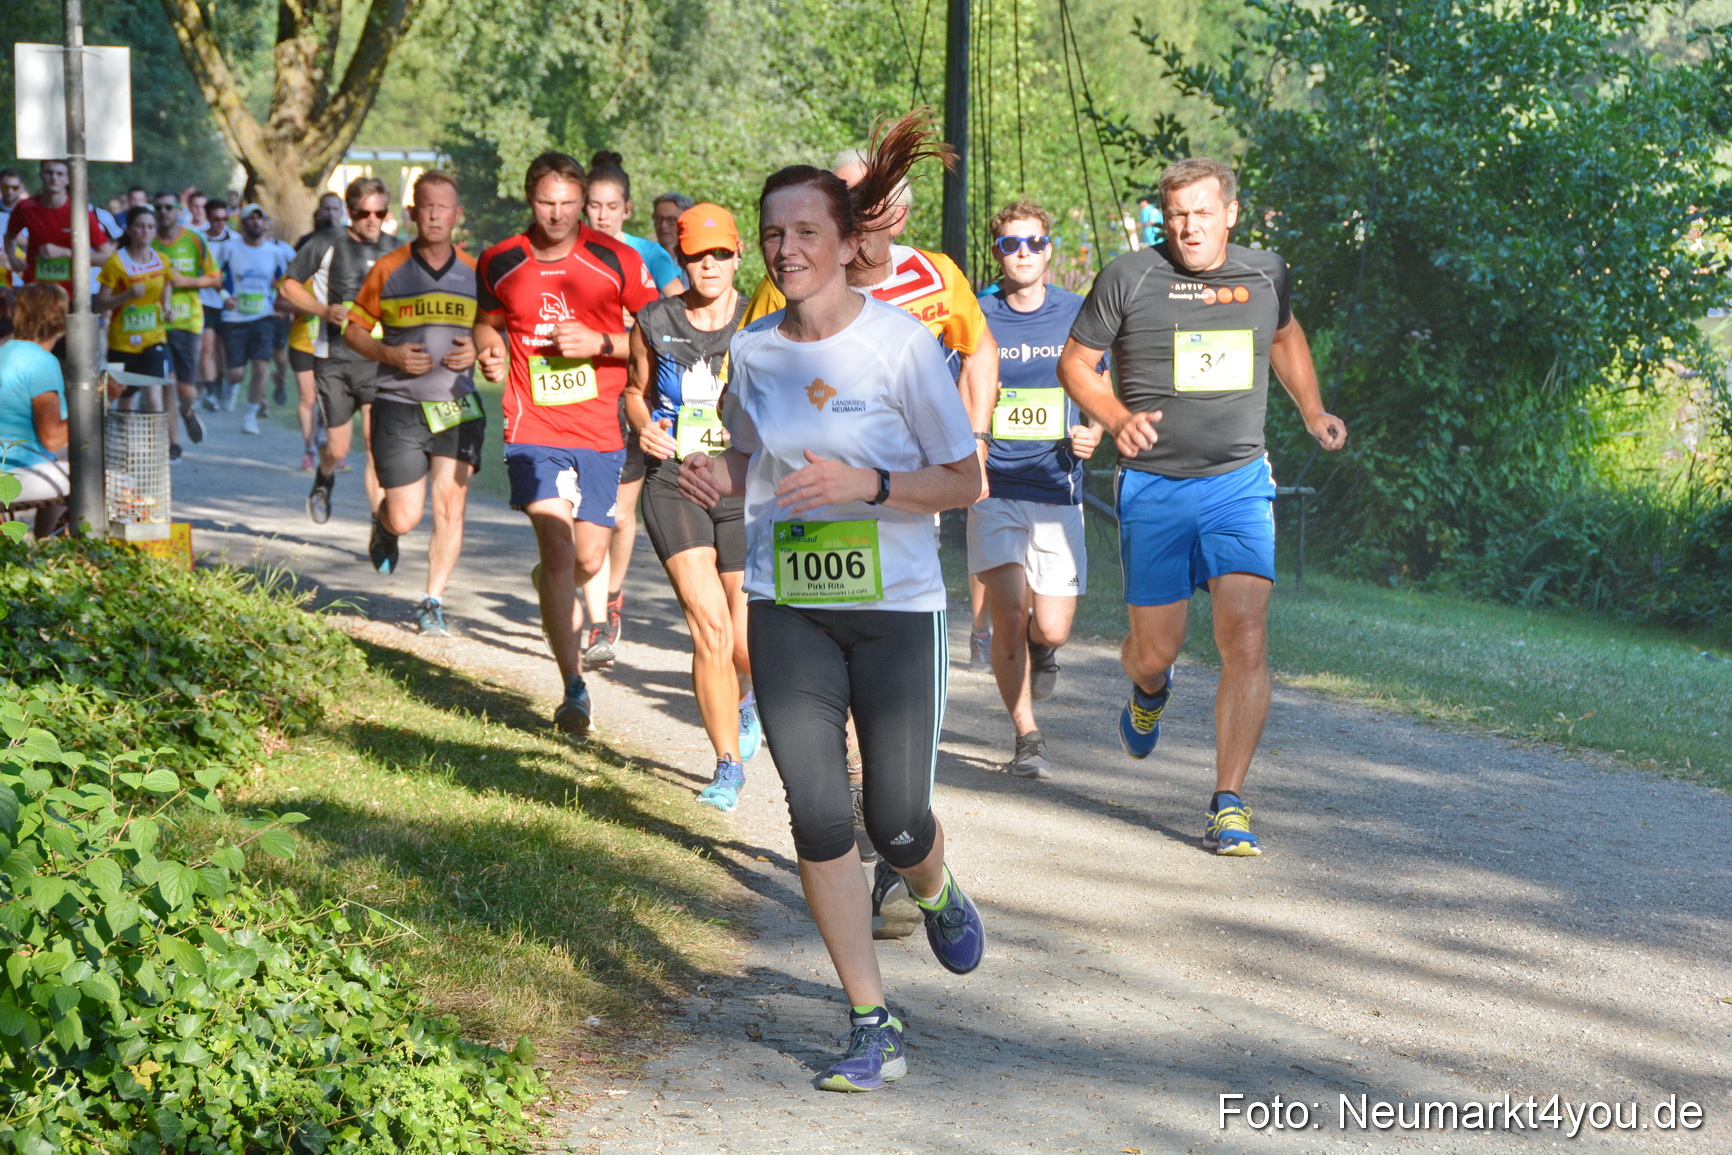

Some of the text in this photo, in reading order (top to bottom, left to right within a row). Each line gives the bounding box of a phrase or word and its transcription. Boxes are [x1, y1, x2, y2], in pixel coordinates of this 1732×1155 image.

[538, 369, 586, 392] 1360
[432, 395, 471, 418] 1384
[1008, 407, 1047, 425] 490
[786, 551, 866, 581] 1006
[807, 581, 845, 590] Pirkl Rita
